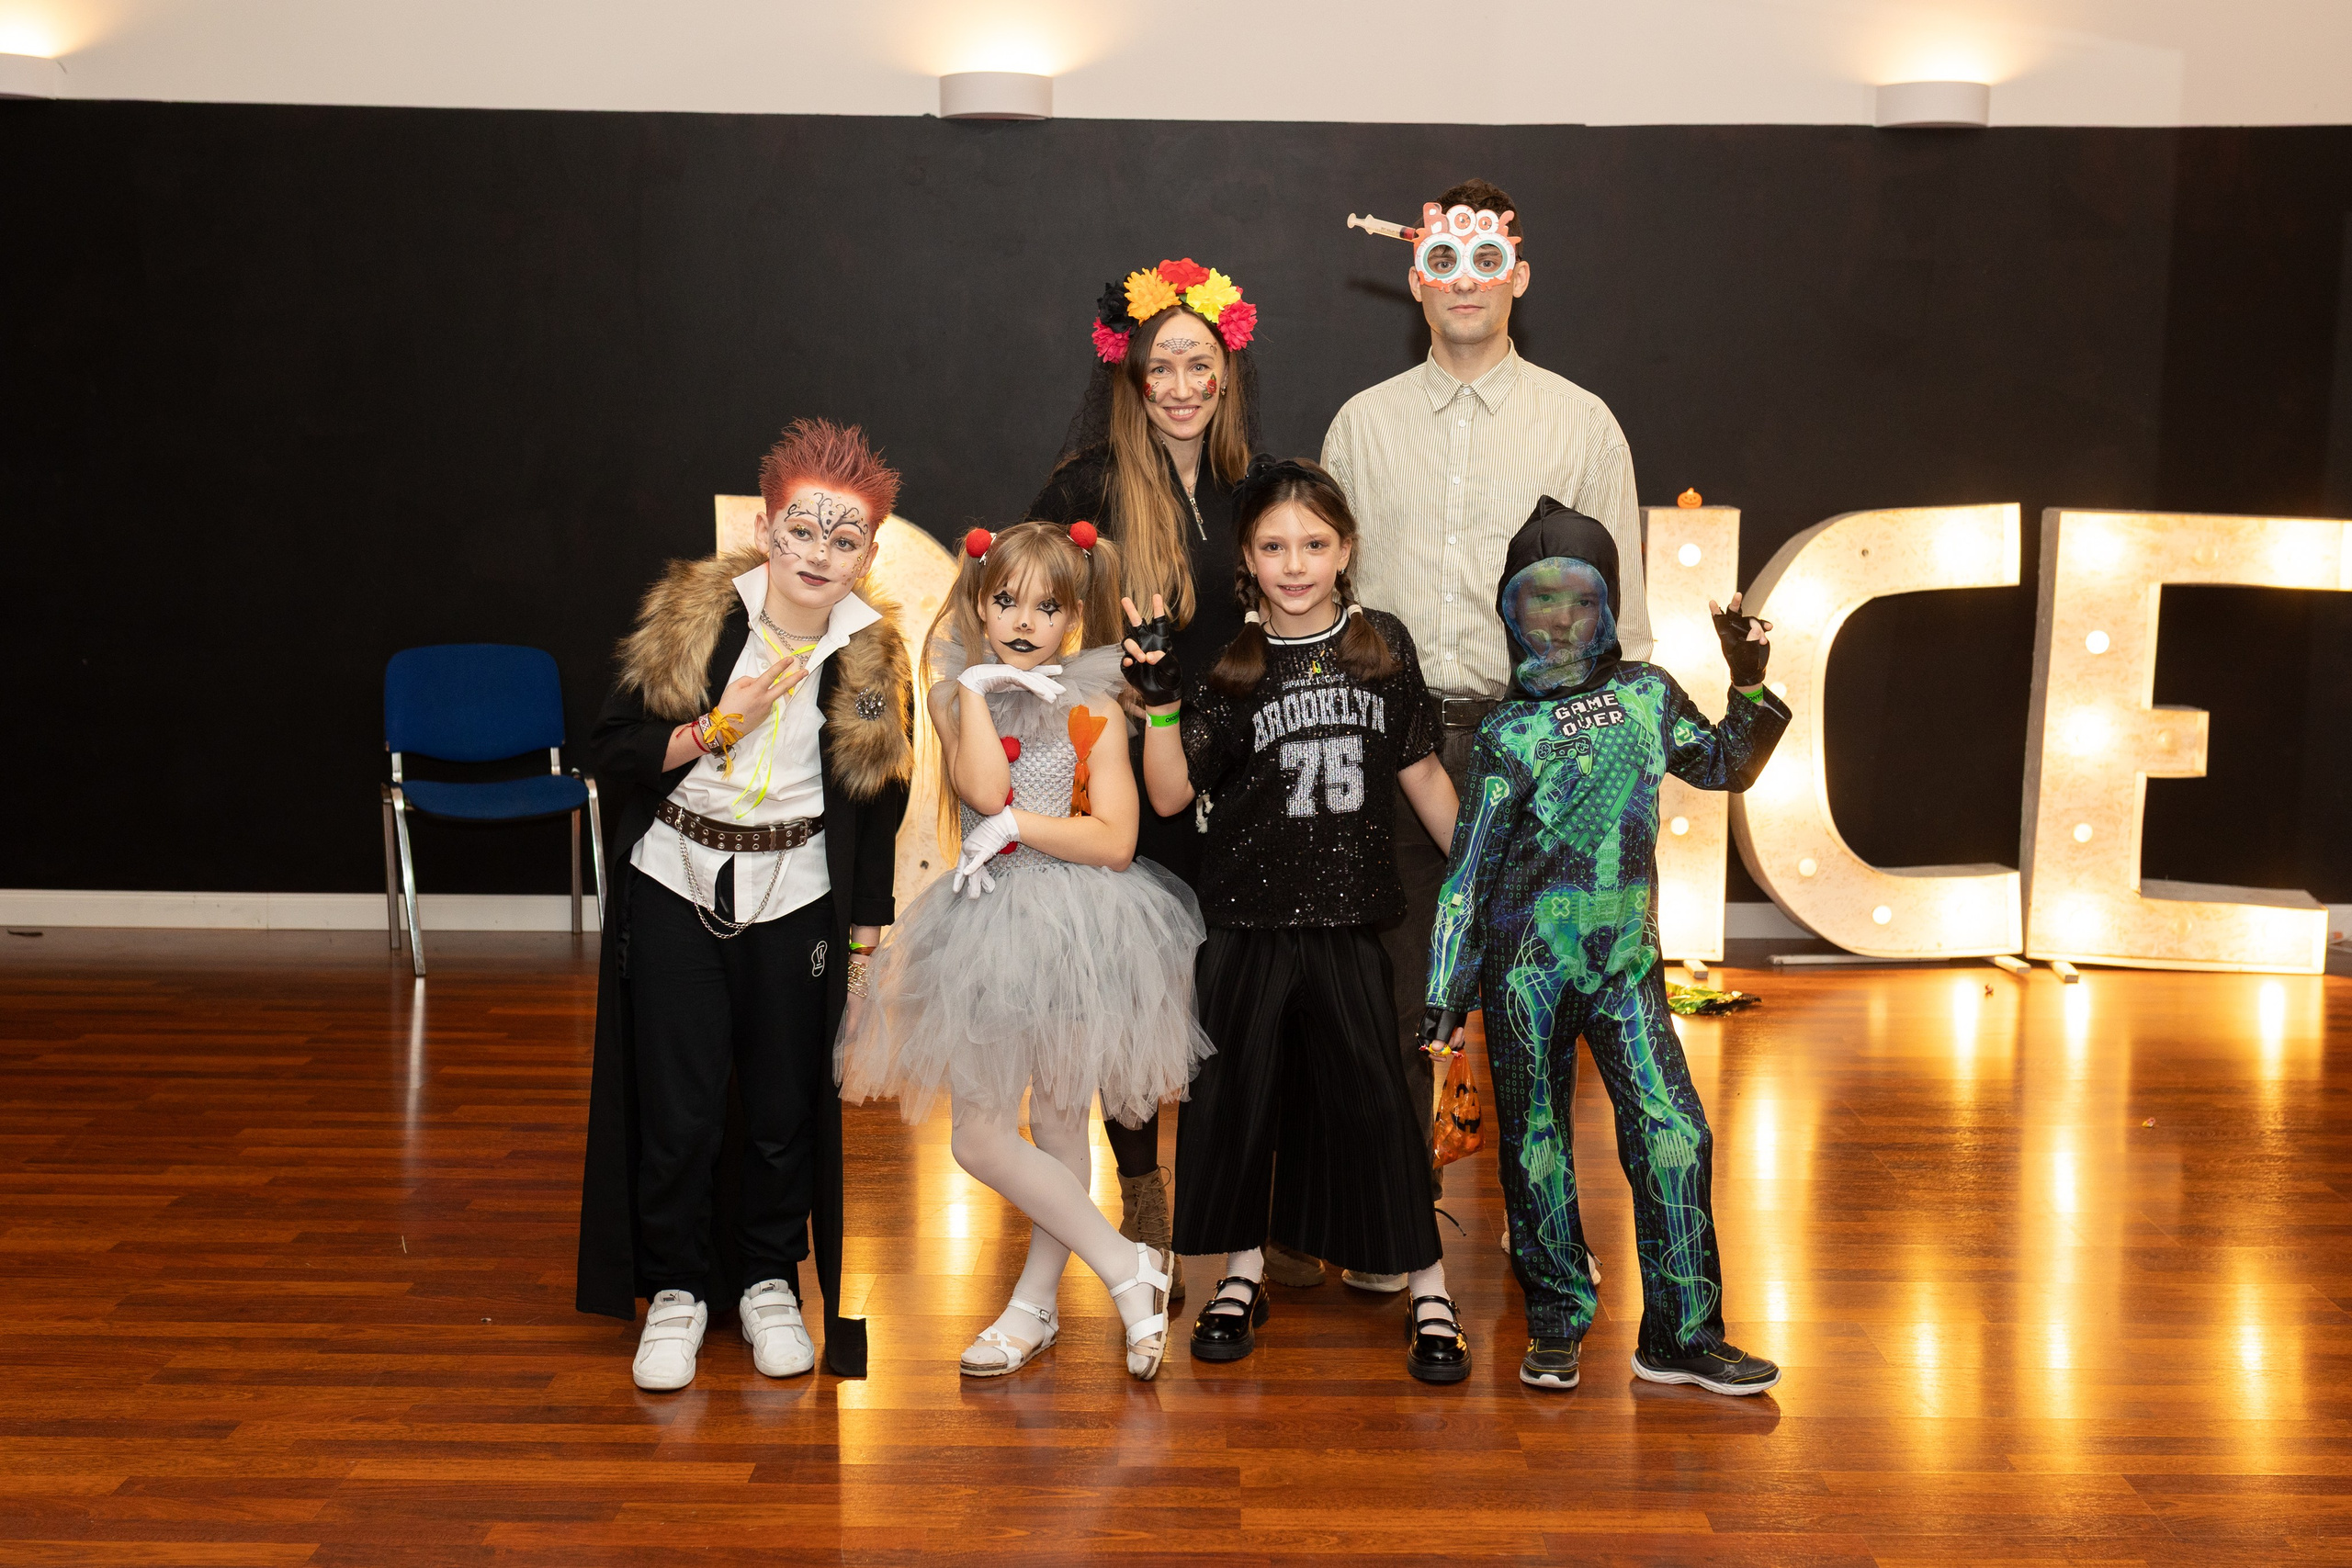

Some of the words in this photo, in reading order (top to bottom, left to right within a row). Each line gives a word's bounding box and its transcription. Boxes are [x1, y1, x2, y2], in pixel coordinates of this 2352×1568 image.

[1252, 688, 1385, 753] BROOKLYN
[1555, 694, 1619, 721] GAME
[1563, 709, 1625, 736] OVER
[1279, 735, 1364, 818] 75
